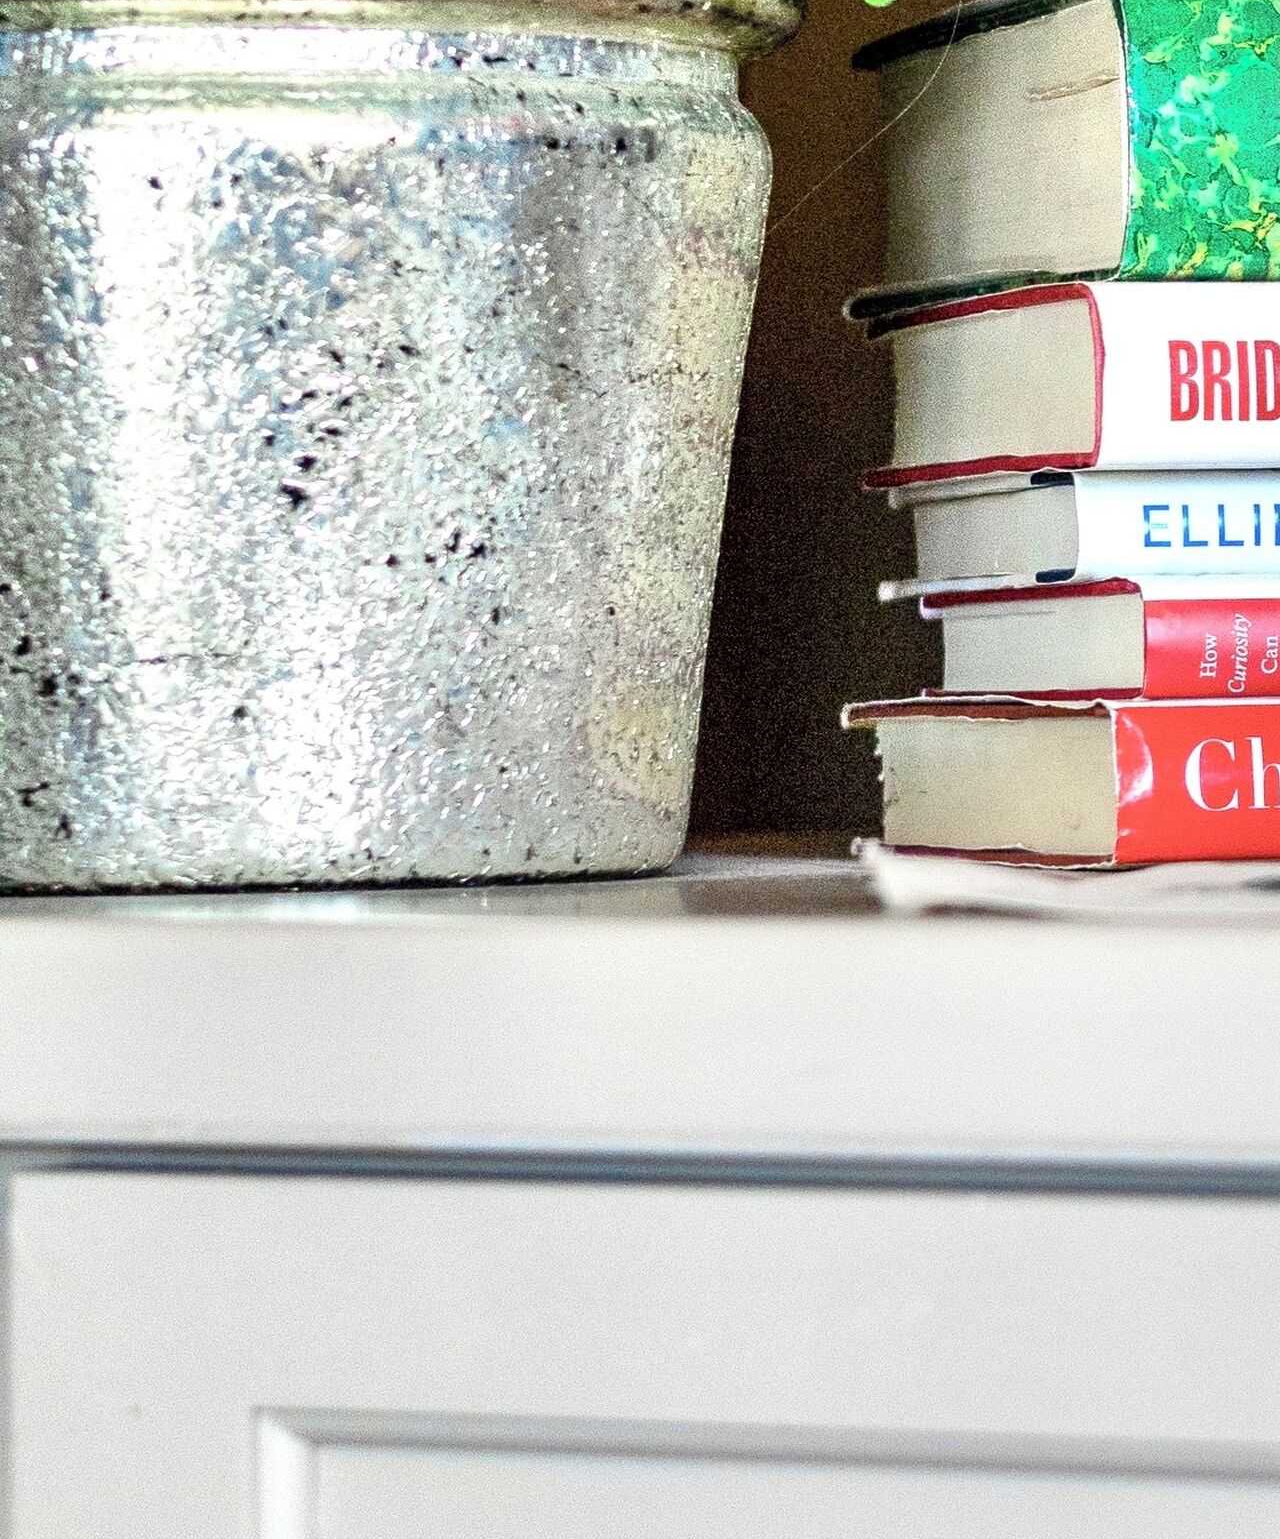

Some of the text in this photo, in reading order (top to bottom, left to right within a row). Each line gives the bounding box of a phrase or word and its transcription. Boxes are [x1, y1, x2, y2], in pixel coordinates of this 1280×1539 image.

[1200, 632, 1218, 678] How
[1227, 613, 1253, 693] Curiosity
[1261, 635, 1279, 674] Can
